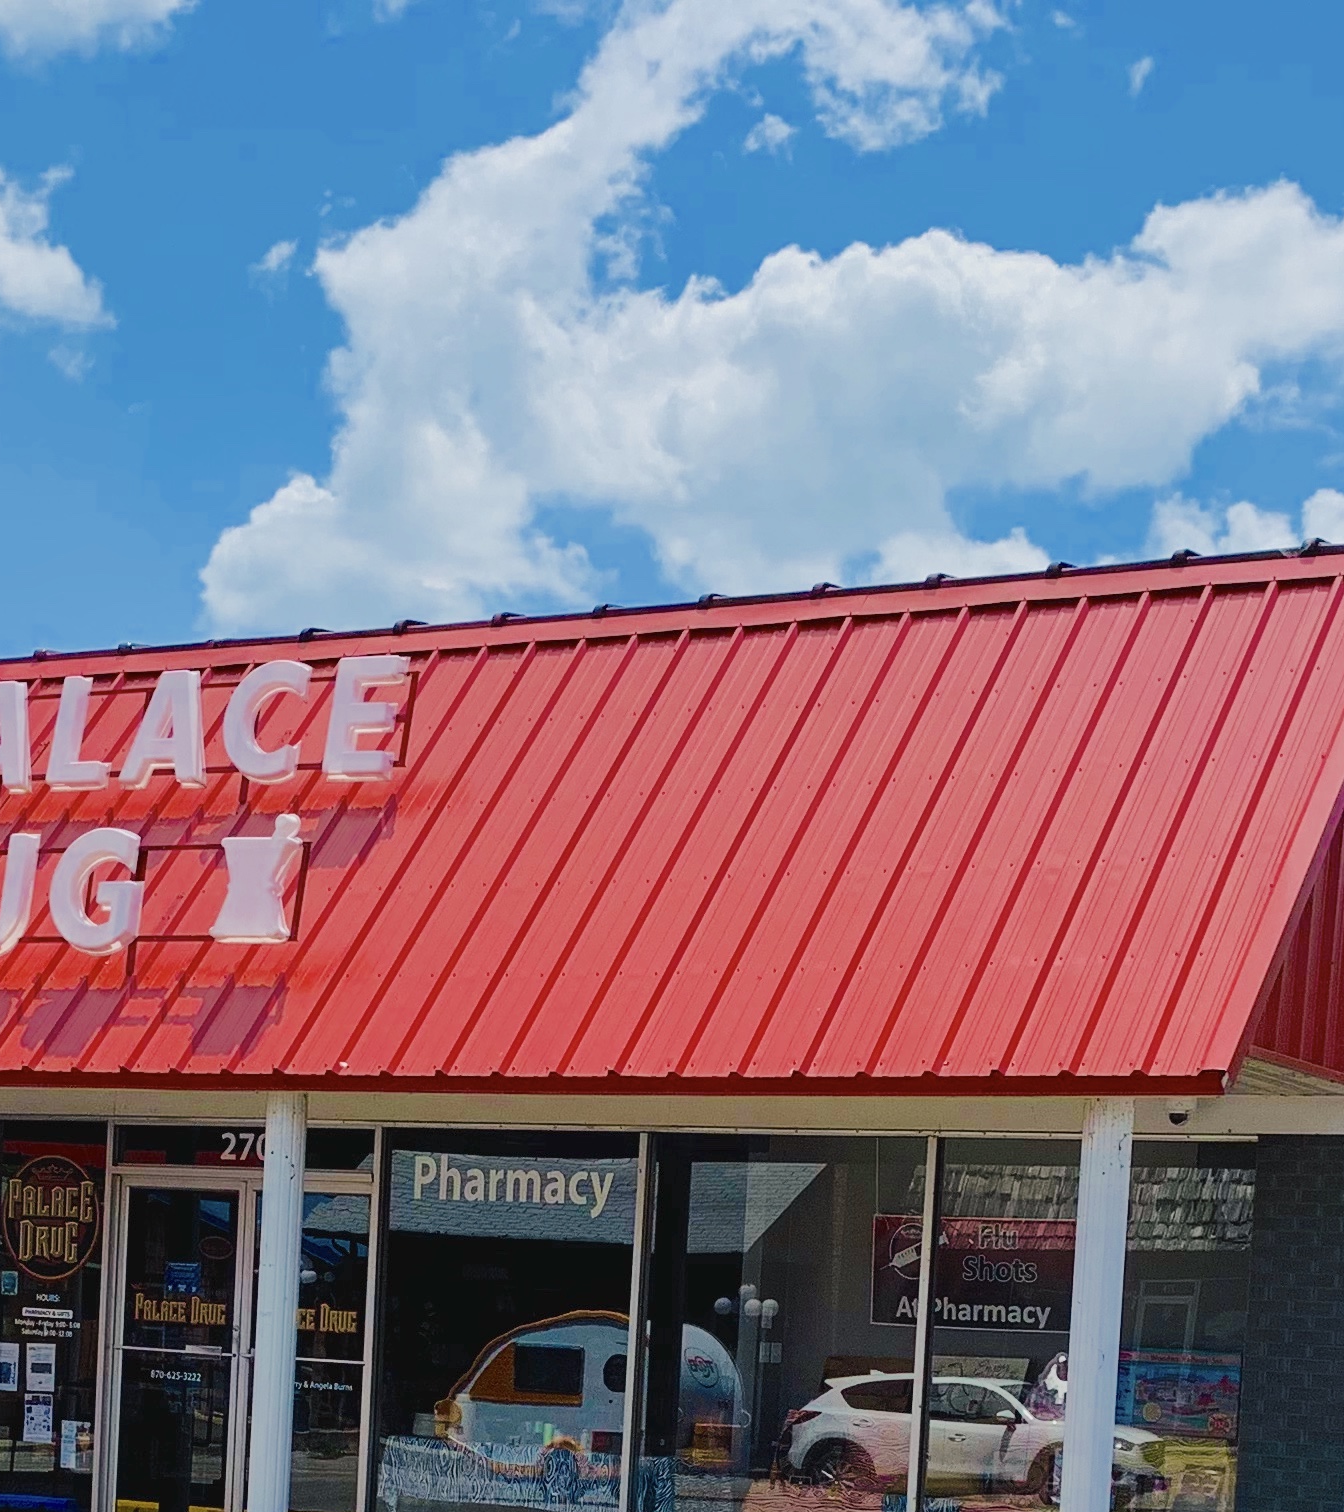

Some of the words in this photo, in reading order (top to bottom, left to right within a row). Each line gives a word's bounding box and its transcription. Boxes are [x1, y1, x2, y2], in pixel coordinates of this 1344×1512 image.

[8, 1178, 95, 1223] PALACE
[413, 1153, 614, 1218] Pharmacy
[18, 1220, 78, 1263] DRUG
[978, 1223, 1019, 1250] Flu
[962, 1255, 1038, 1283] Shots
[150, 1369, 202, 1382] 870-625-3222
